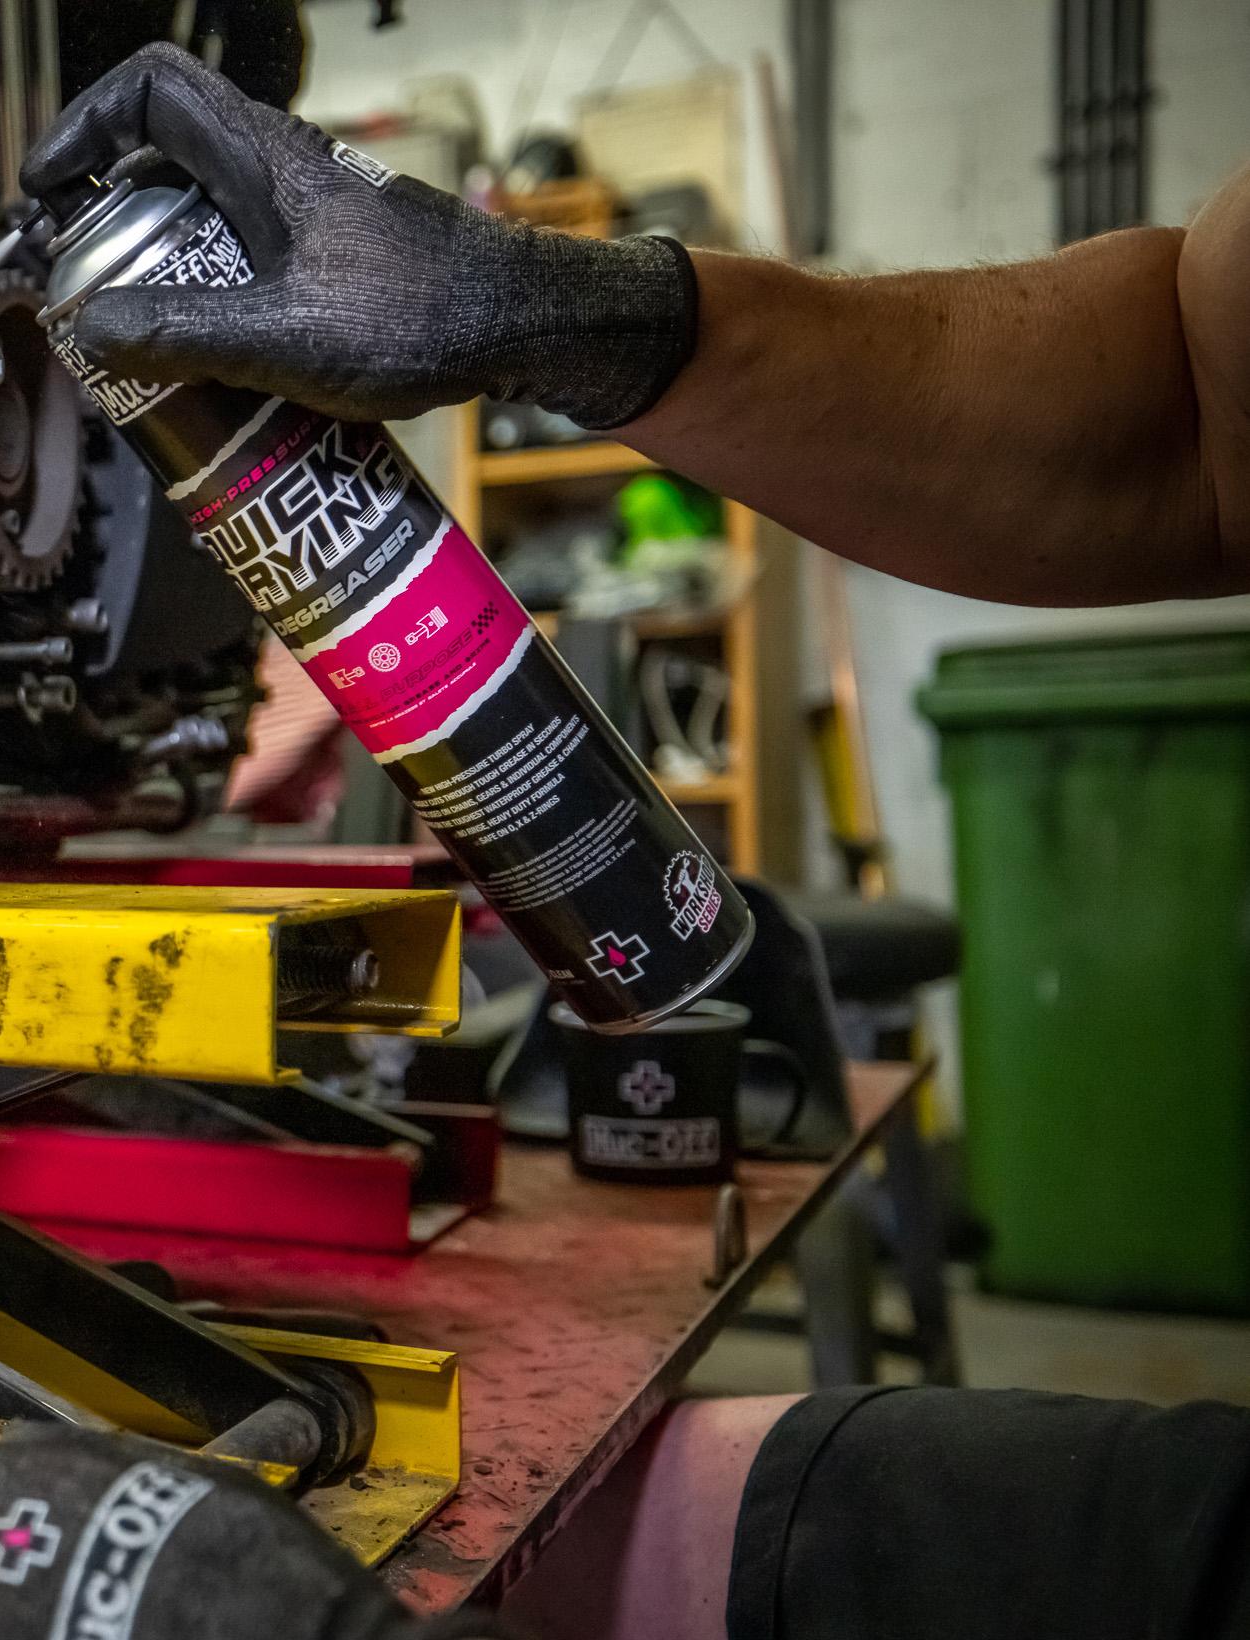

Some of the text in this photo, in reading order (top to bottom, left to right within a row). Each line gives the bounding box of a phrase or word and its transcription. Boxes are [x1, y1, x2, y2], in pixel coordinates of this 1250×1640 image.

[272, 518, 416, 638] DEGREASER
[433, 758, 490, 791] HIGH-PRESSURE
[487, 741, 514, 763] TURBO
[510, 722, 536, 746] SPRAY
[442, 782, 475, 802] THROUGH
[473, 768, 500, 788] TOUGH
[497, 747, 528, 773] GREASE
[525, 740, 536, 752] IN
[533, 716, 562, 746] SECONDS
[449, 796, 479, 813] CHAINS,
[475, 783, 501, 802] GEARS
[499, 778, 509, 789] &
[506, 749, 548, 784] INDIVIDUAL
[544, 713, 580, 755] COMPONENTS
[452, 807, 485, 826] TOUGHEST
[483, 778, 533, 814] WATERPROOF
[530, 757, 560, 784] GREASE
[556, 752, 565, 763] &
[561, 735, 581, 757] CHAIN
[478, 831, 499, 846] SAFE
[495, 827, 509, 838] ON
[521, 813, 531, 824] &
[528, 793, 561, 820] Z-RINGS
[486, 809, 512, 827] HEAVY
[510, 797, 532, 815] DUTY
[529, 771, 565, 802] FORMULA
[698, 890, 721, 932] SERIES
